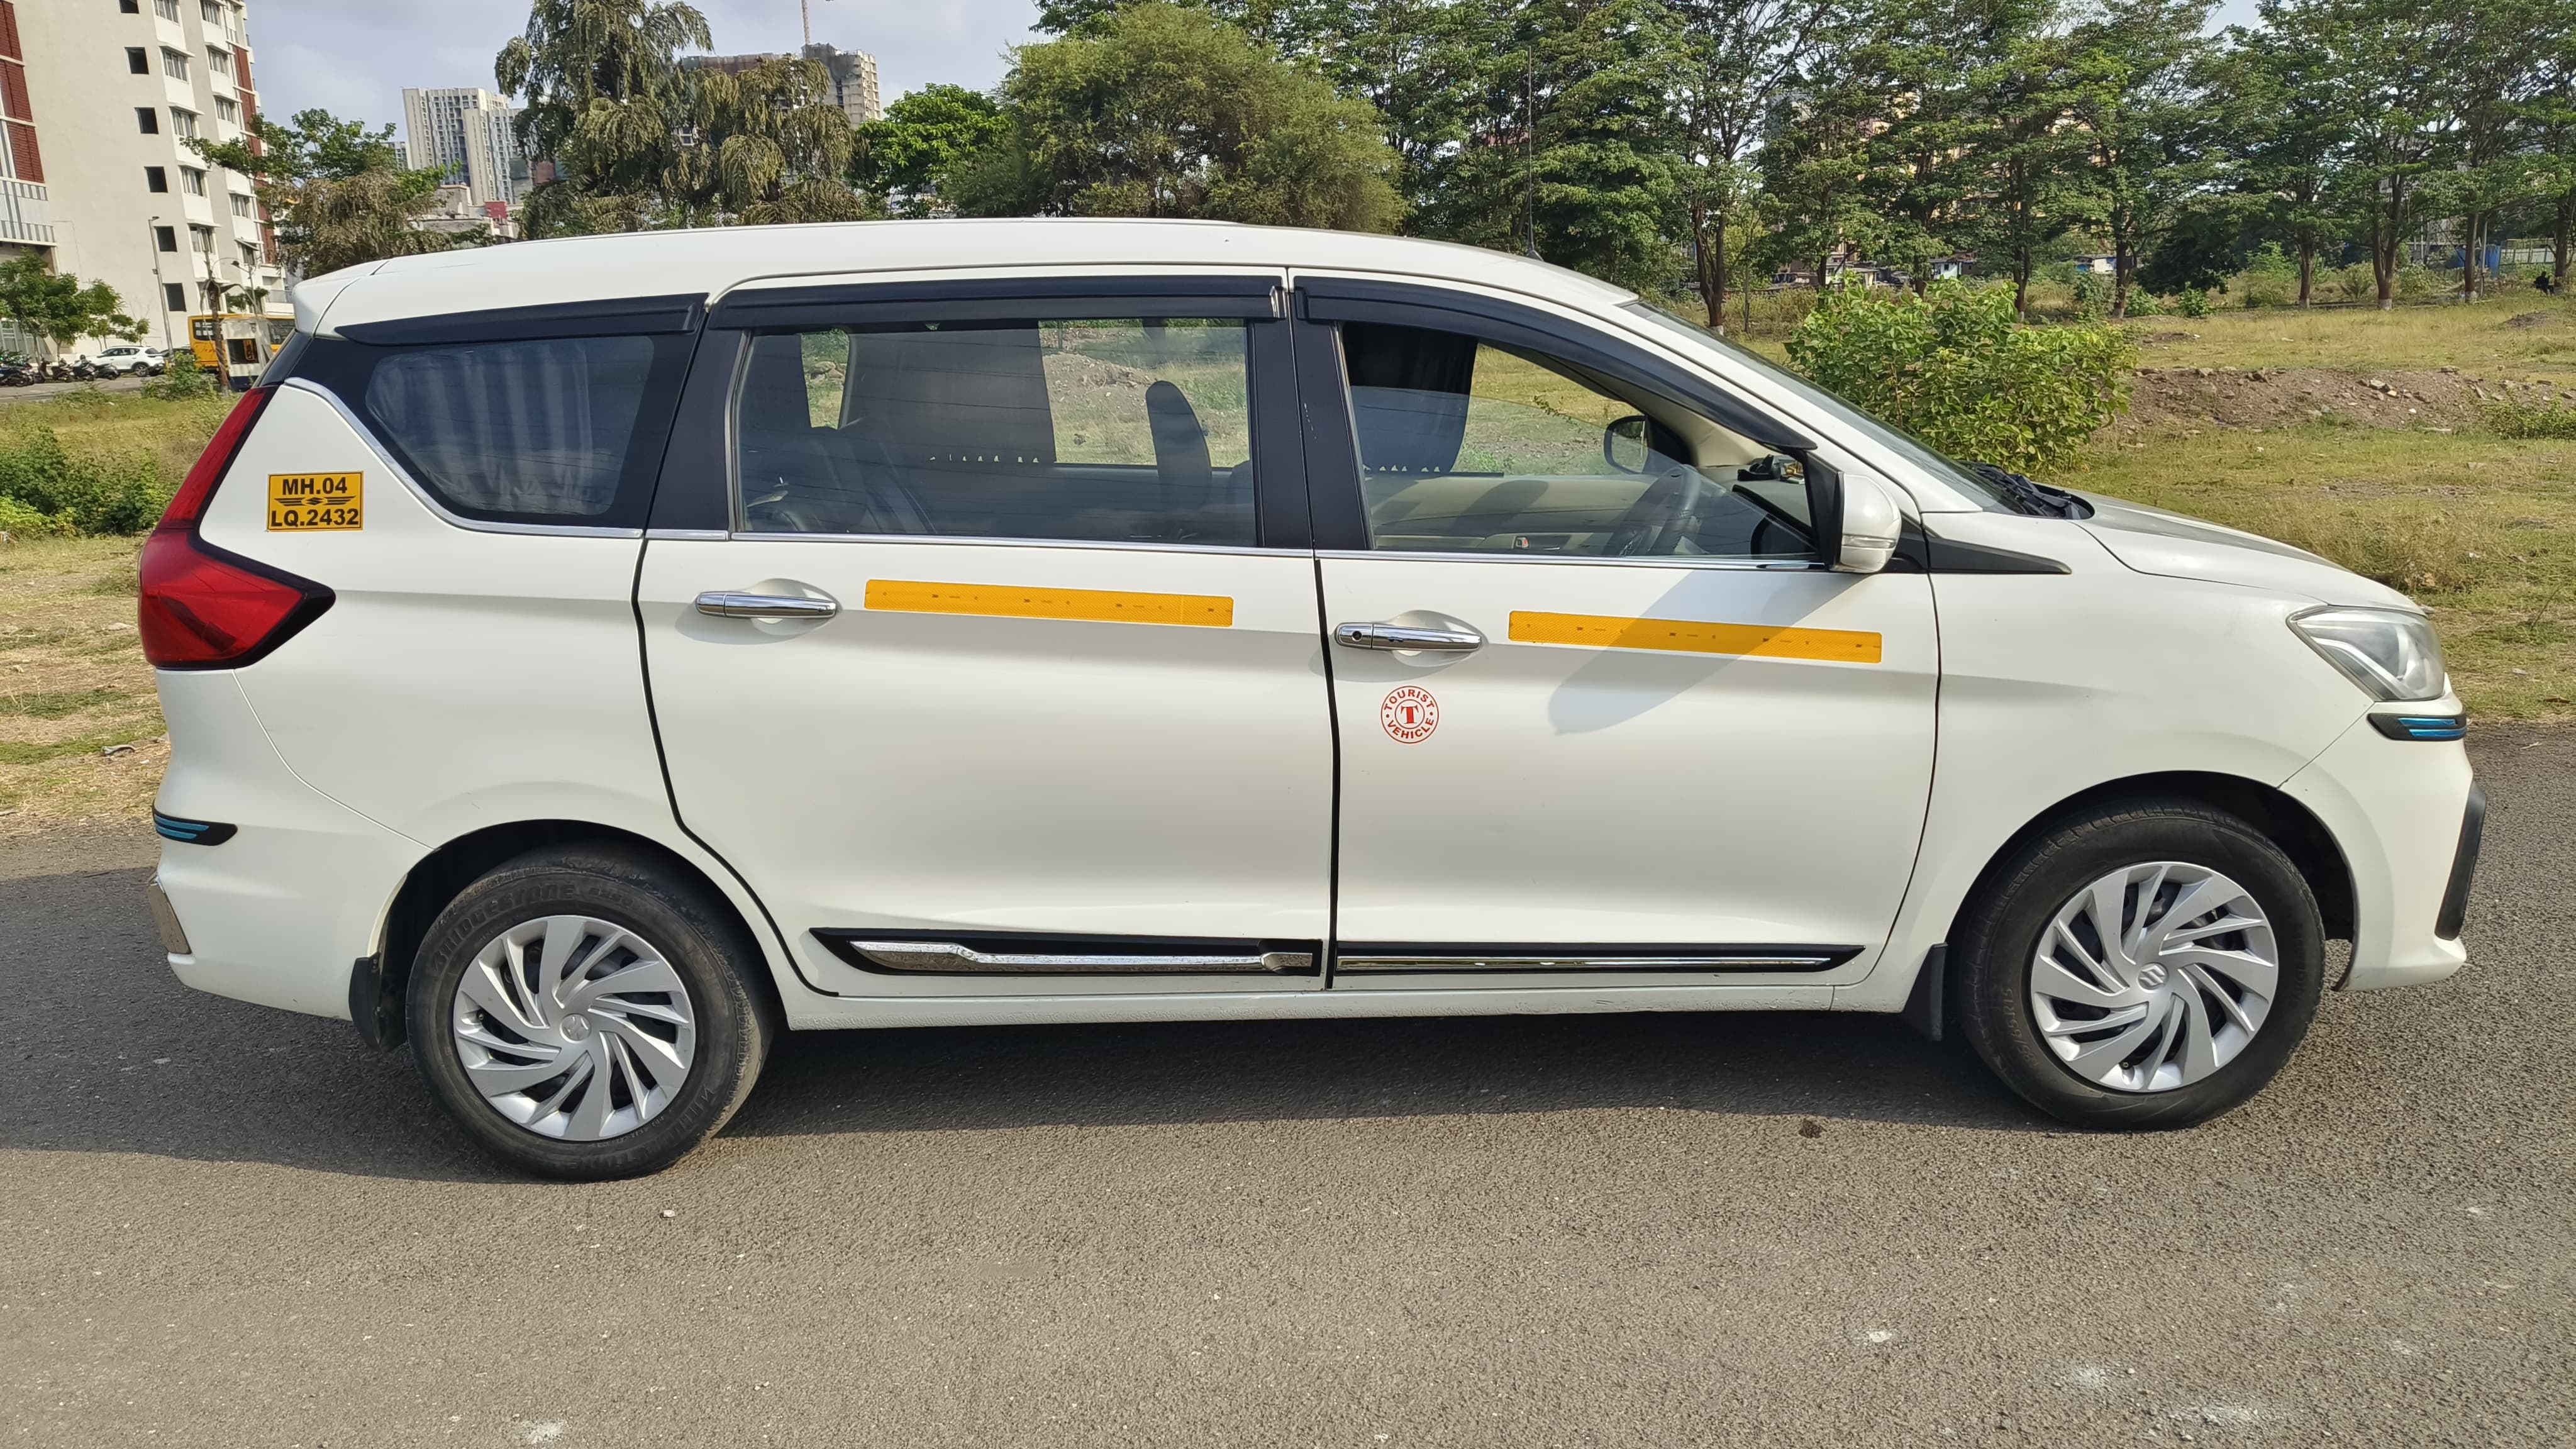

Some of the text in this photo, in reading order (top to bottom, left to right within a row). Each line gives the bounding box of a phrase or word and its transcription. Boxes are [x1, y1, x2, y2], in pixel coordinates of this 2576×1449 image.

[282, 477, 347, 495] MH.04
[271, 508, 358, 527] LQ.2432
[1384, 689, 1435, 711] TOURIST
[1400, 704, 1419, 724] T
[1387, 718, 1434, 739] VEHICLE
